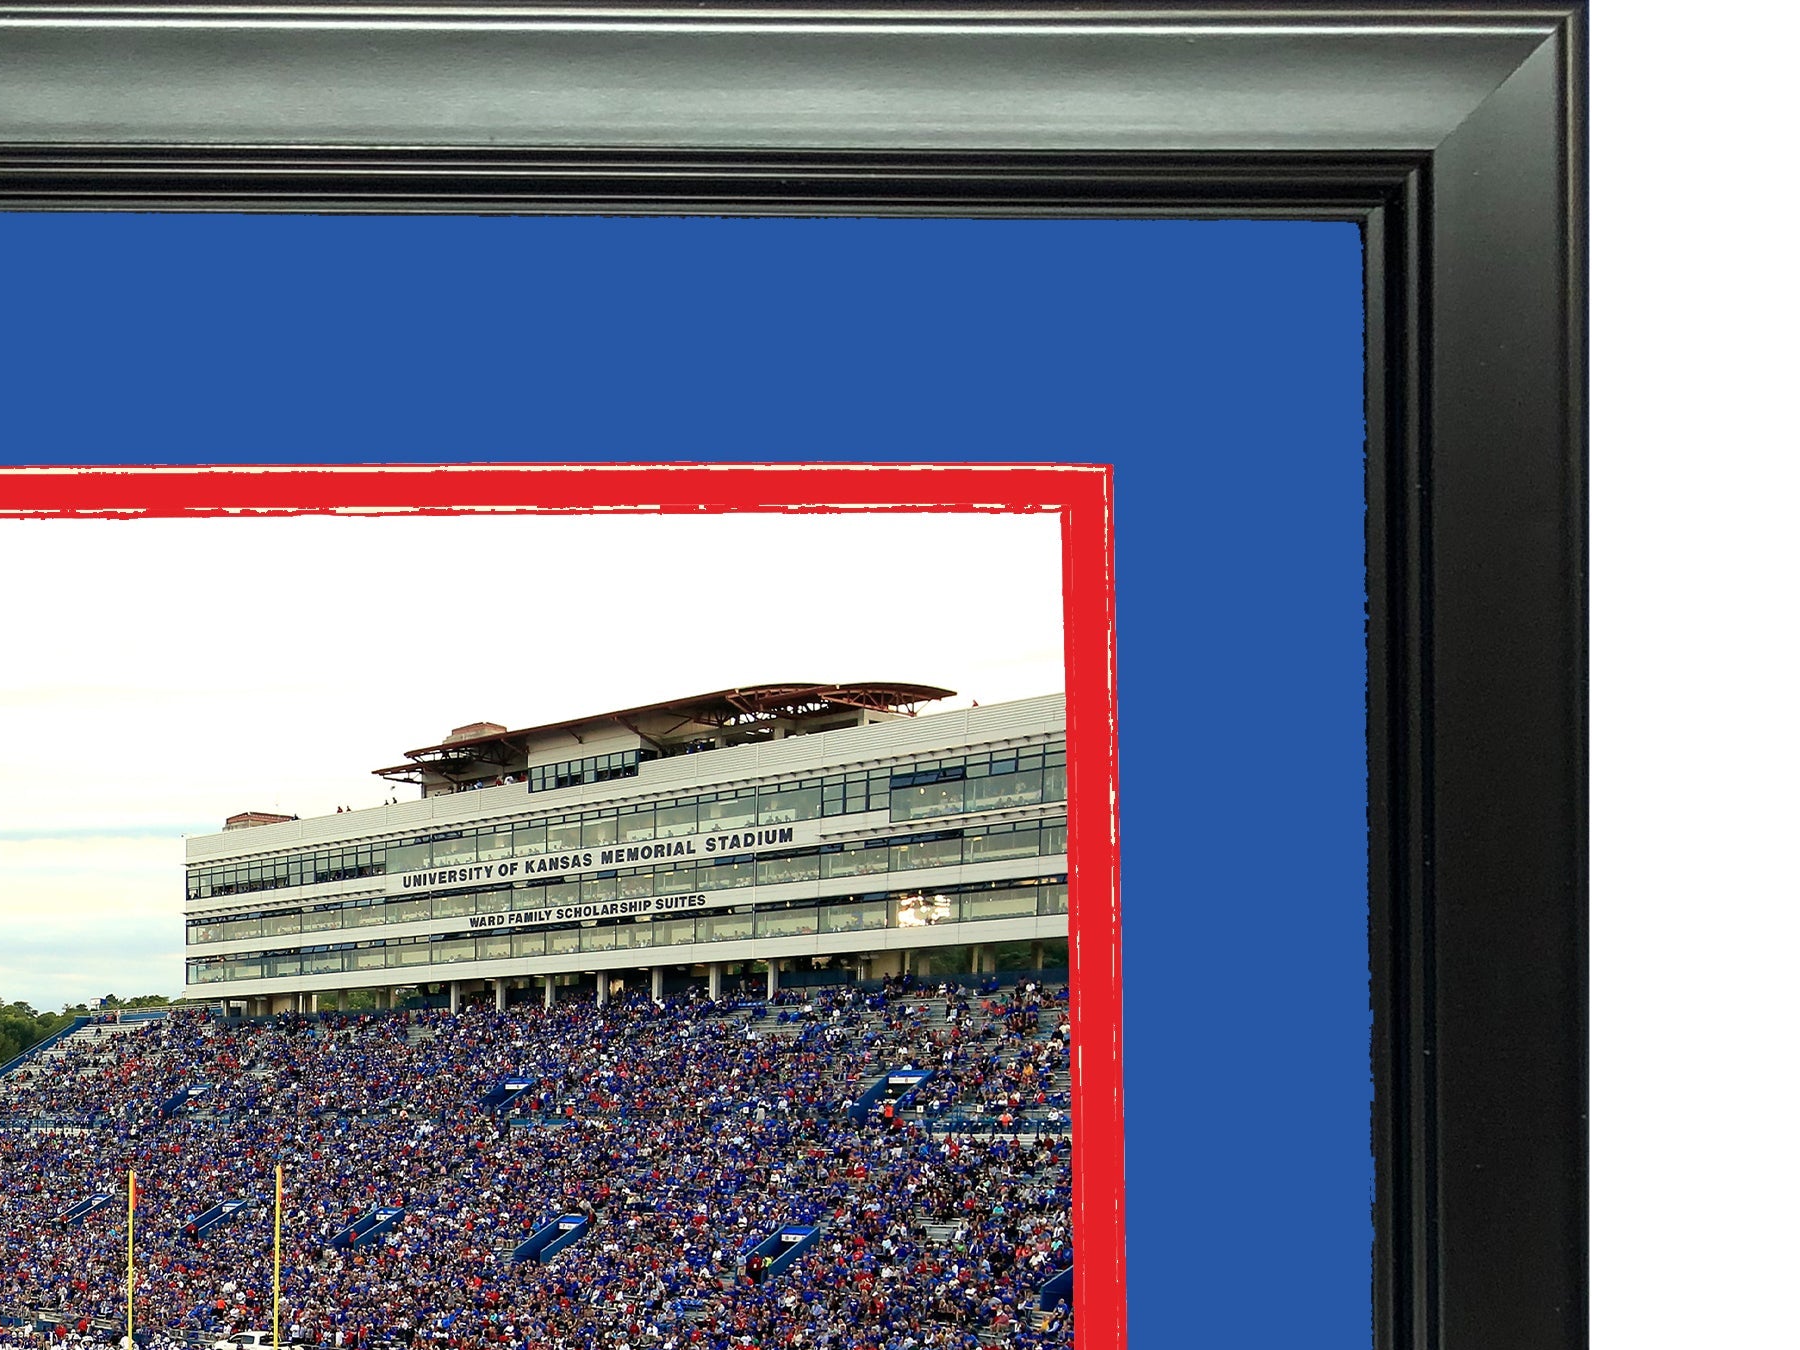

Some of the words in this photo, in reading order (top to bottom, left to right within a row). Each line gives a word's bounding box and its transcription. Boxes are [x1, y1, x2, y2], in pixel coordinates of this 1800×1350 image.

[402, 865, 494, 889] UNIVERSITY
[498, 862, 519, 877] OF
[525, 853, 593, 874] KANSAS
[600, 840, 697, 865] MEMORIAL
[705, 827, 794, 852] STADIUM
[469, 914, 505, 928] WARD
[508, 909, 552, 924] FAMILY
[556, 901, 652, 919] SCHOLARSHIP
[655, 894, 706, 910] SUITES
